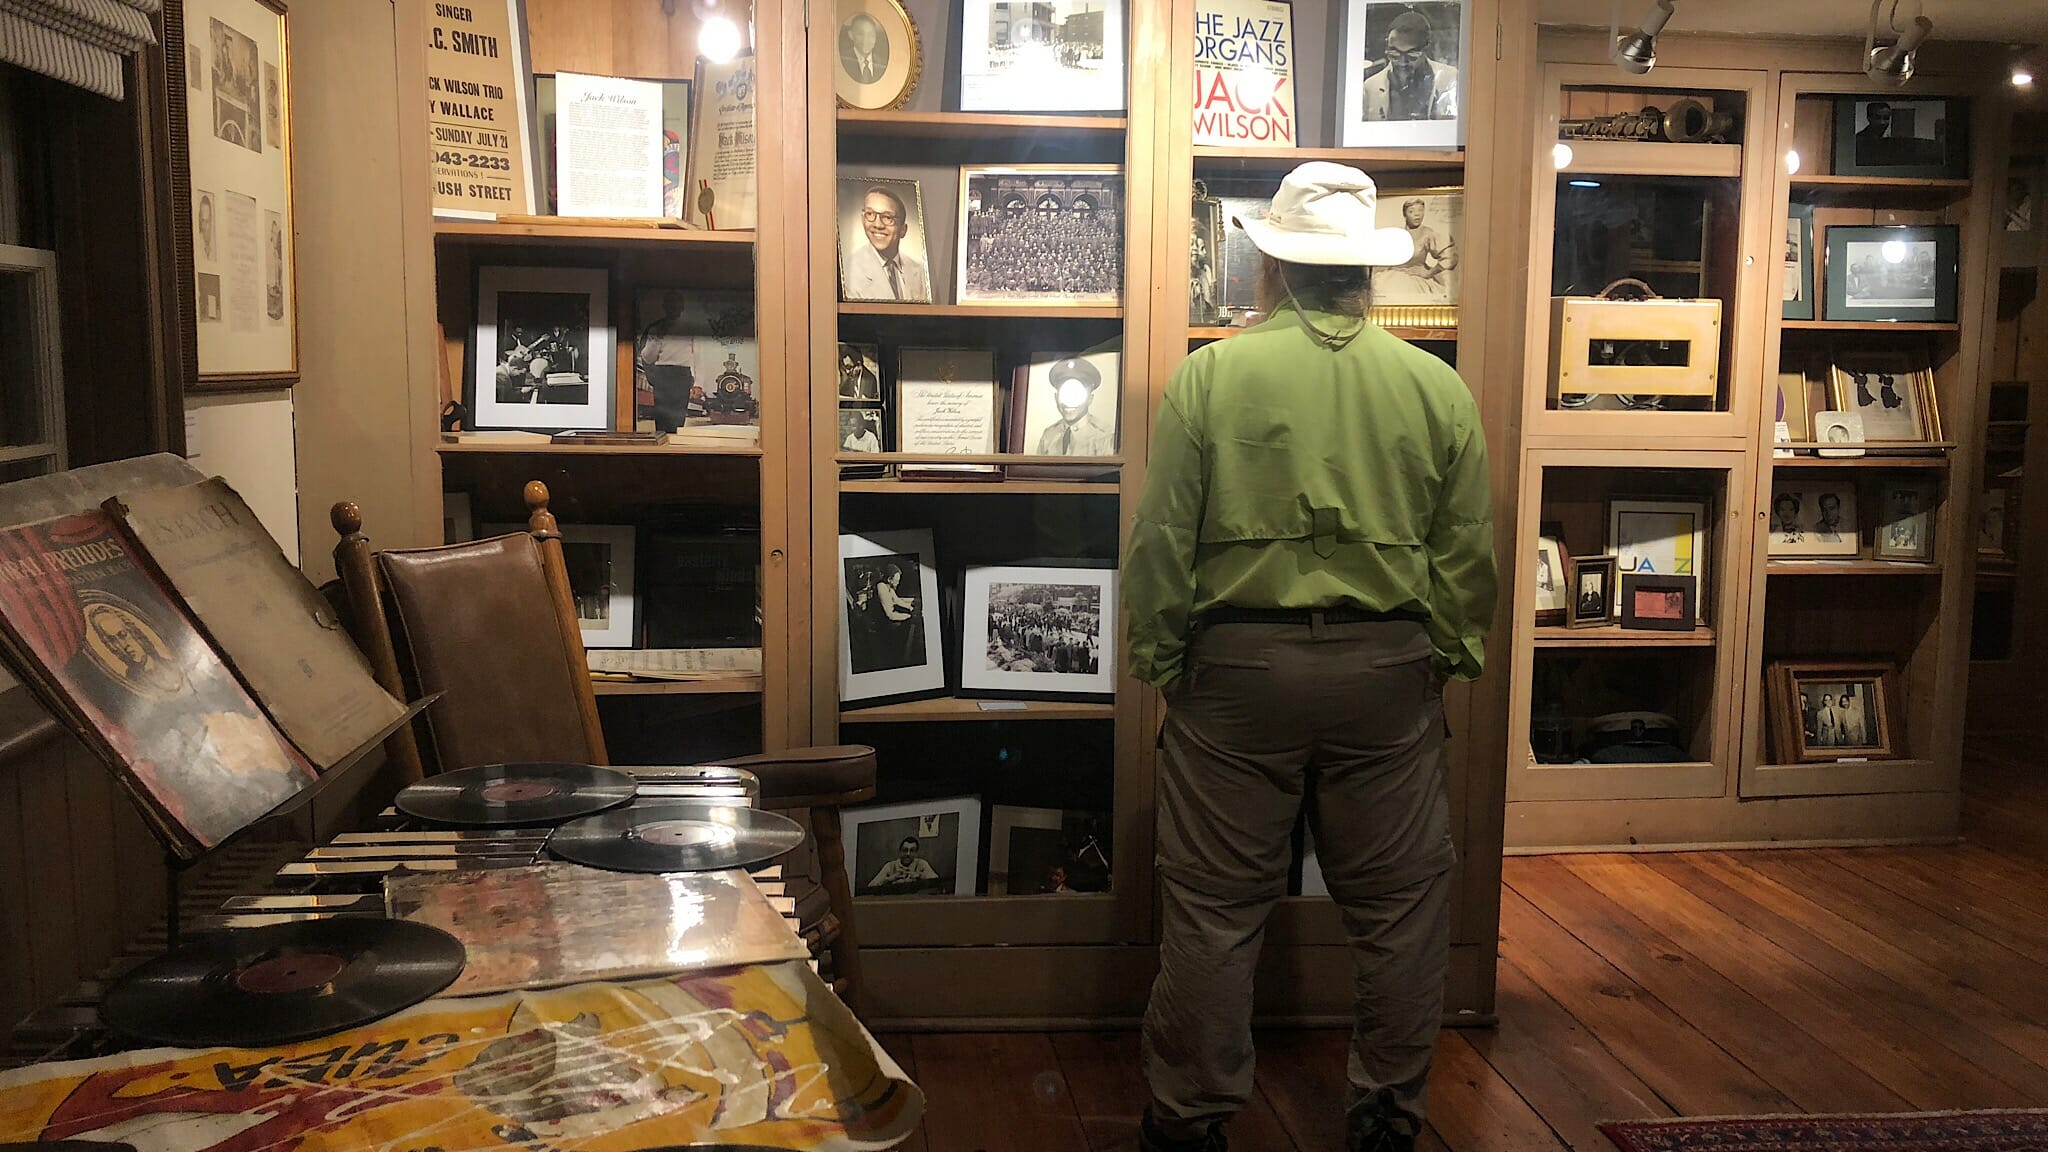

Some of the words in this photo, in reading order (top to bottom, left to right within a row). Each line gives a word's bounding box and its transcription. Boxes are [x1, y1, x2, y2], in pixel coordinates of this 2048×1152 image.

[435, 3, 473, 22] SINGER
[1195, 12, 1224, 36] HE
[1232, 17, 1286, 43] JAZZ
[452, 30, 498, 58] SMITH
[443, 79, 480, 97] WILSON
[482, 84, 504, 100] TRIO
[440, 101, 494, 121] WALLACE
[1194, 112, 1290, 142] WILSON
[435, 127, 472, 144] SUNDAY
[477, 132, 498, 148] JULY
[500, 135, 508, 149] 21
[435, 181, 462, 197] USH
[469, 184, 512, 201] STREET
